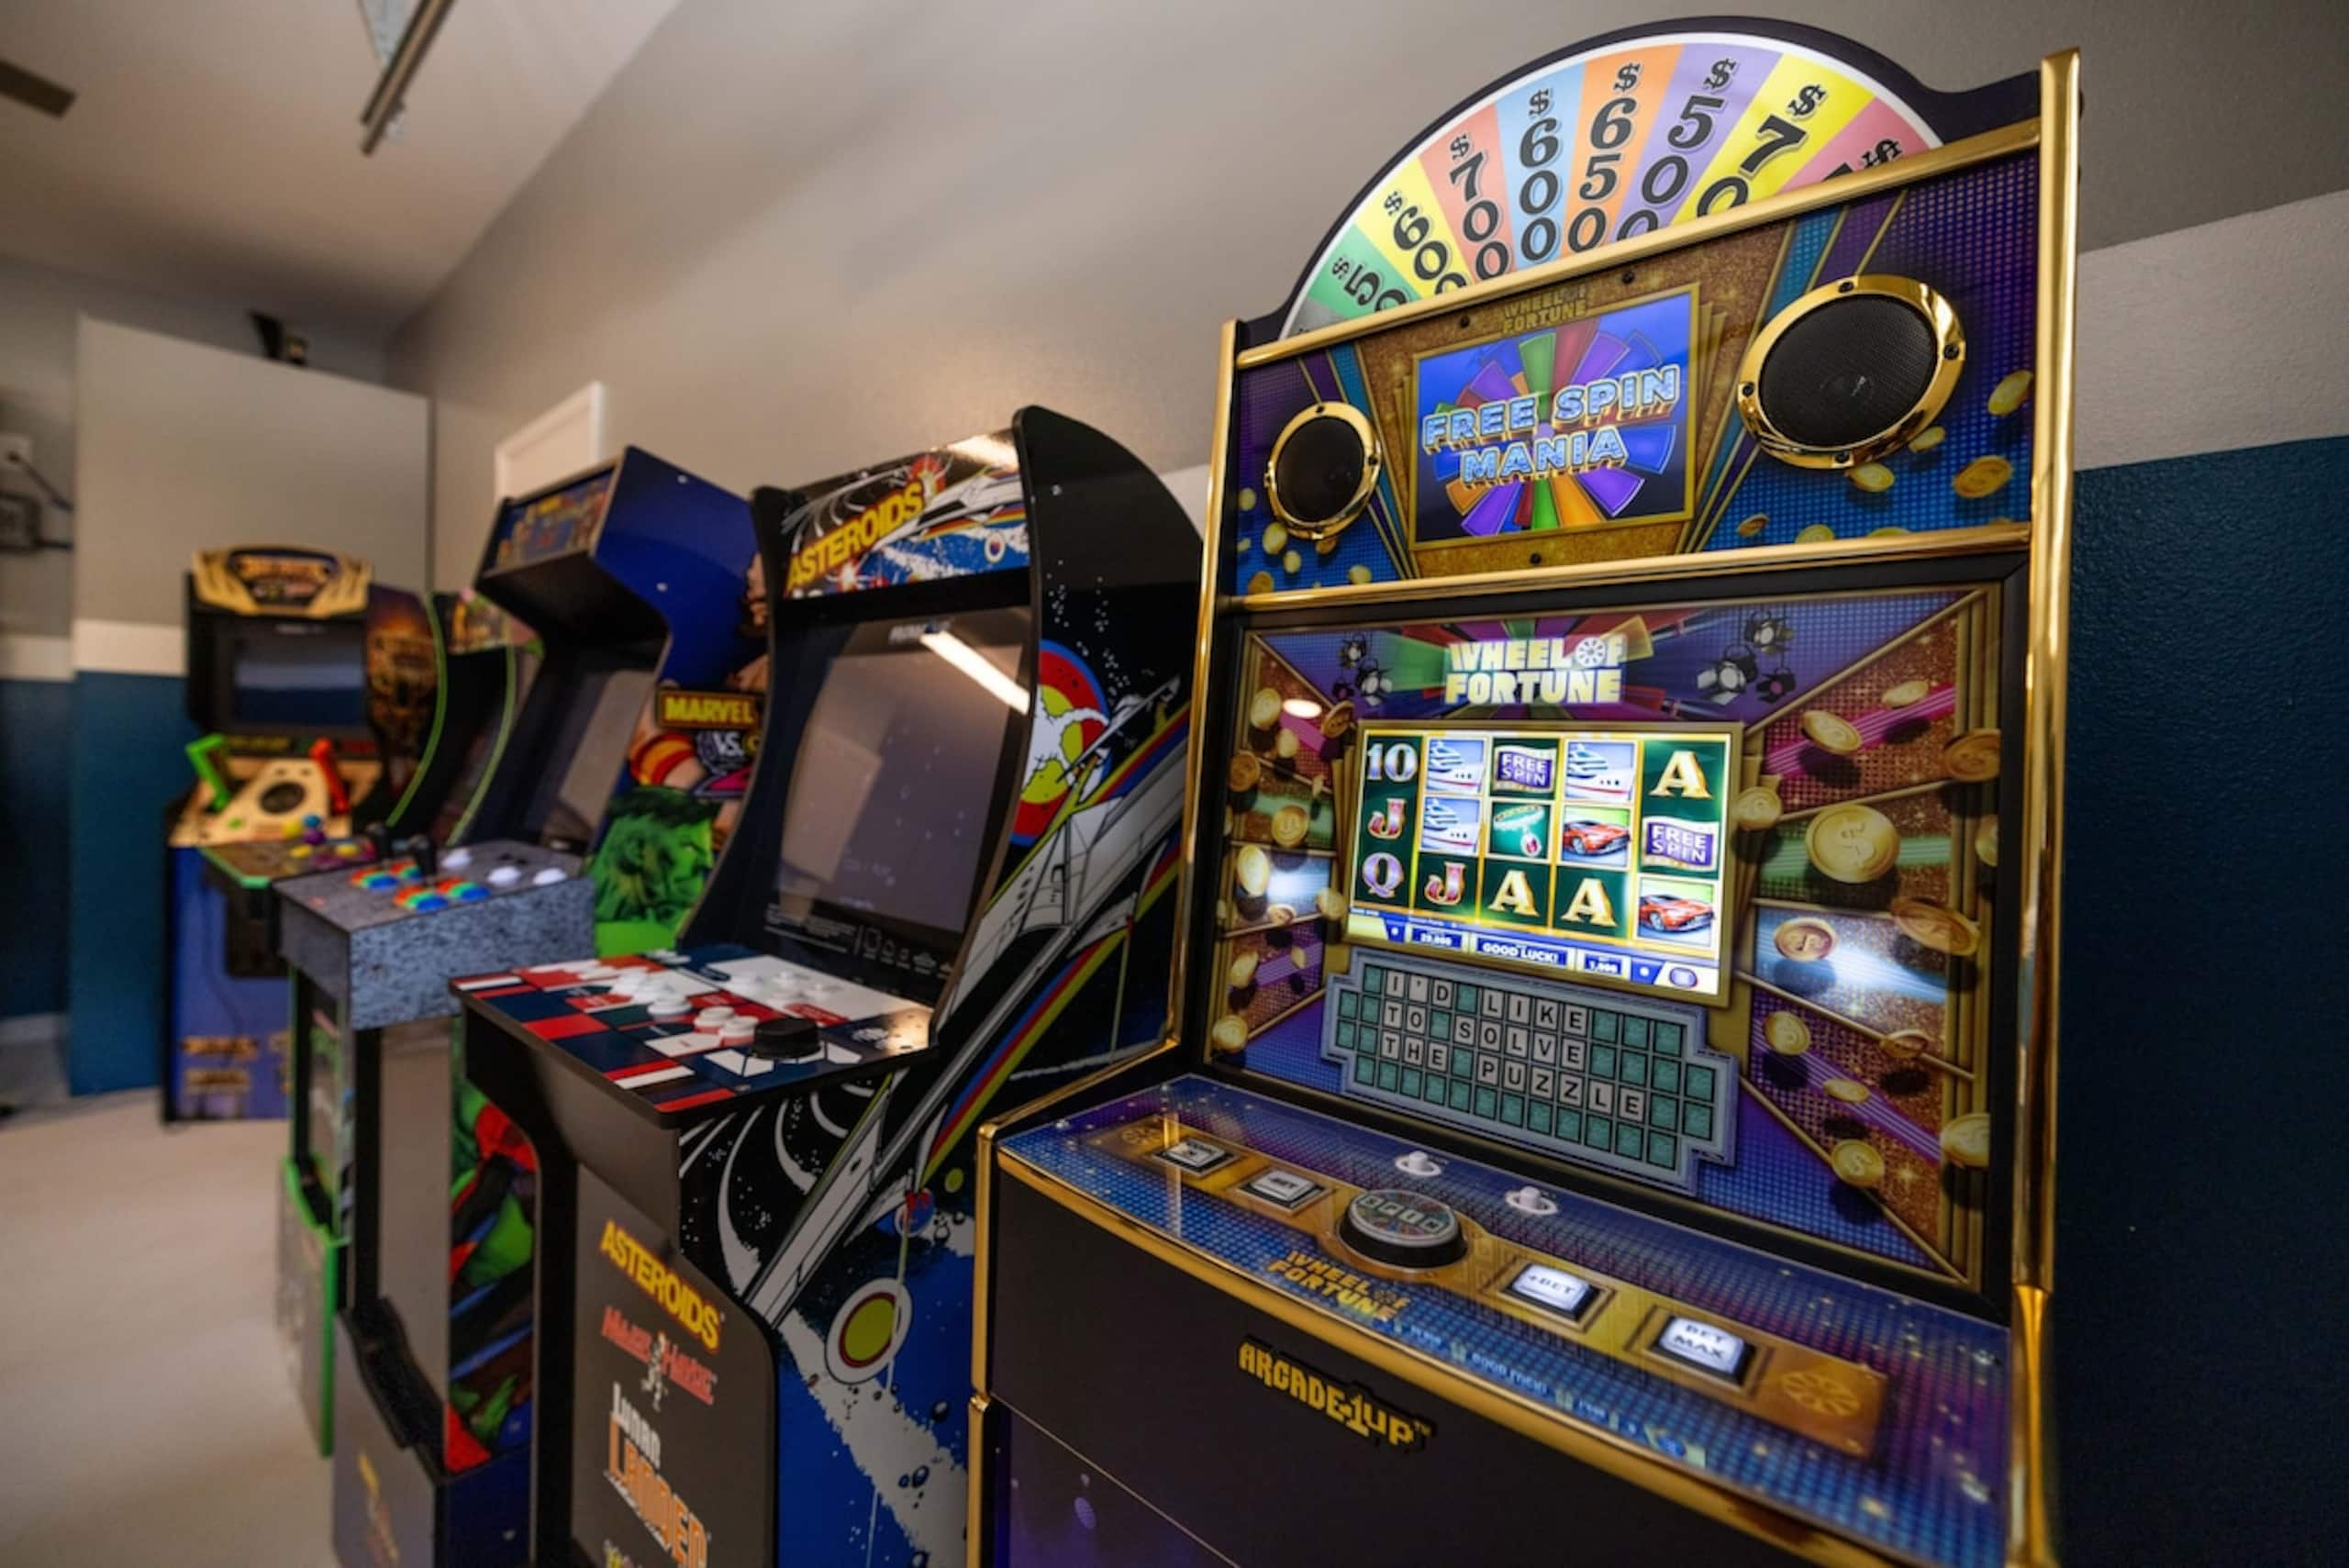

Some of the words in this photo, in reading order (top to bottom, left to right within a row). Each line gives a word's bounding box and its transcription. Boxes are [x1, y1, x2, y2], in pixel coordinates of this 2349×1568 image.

[1519, 89, 1561, 261] $600
[1568, 62, 1641, 253] $650
[1448, 133, 1509, 281] $700
[1423, 395, 1539, 454] FREE
[1552, 363, 1680, 428] SPIN
[1460, 425, 1629, 488] MANIA
[785, 482, 926, 595] ASTEROIDS
[1449, 637, 1571, 673] WHEEL
[1444, 668, 1622, 705] FORTUNE
[665, 697, 753, 724] MARVEL
[1366, 742, 1419, 783] 10
[1500, 751, 1548, 774] FREE
[1500, 767, 1547, 786] SPIN
[1650, 750, 1712, 799] A
[1368, 797, 1407, 840] J
[1652, 825, 1707, 850] FREE
[1362, 851, 1404, 898] Q
[1651, 840, 1706, 863] SPIN
[1424, 862, 1466, 906] J
[1486, 870, 1539, 917] A
[1561, 877, 1618, 928] A
[1482, 941, 1519, 958] GOOD
[1520, 945, 1558, 962] LUCK!
[1390, 975, 1449, 1002] I'D
[1485, 992, 1584, 1028] LIKE
[1386, 1006, 1422, 1029] TO
[1459, 1021, 1581, 1064] SOLVE
[1385, 1036, 1443, 1066] THE
[1481, 1062, 1642, 1116] PUZZLE
[598, 1219, 719, 1353] ASTEROIDS
[1266, 1259, 1397, 1321] FORTUNE
[1286, 1250, 1371, 1296] WHEEL
[1674, 1335, 1726, 1360] MAX
[1685, 1324, 1726, 1344] BET
